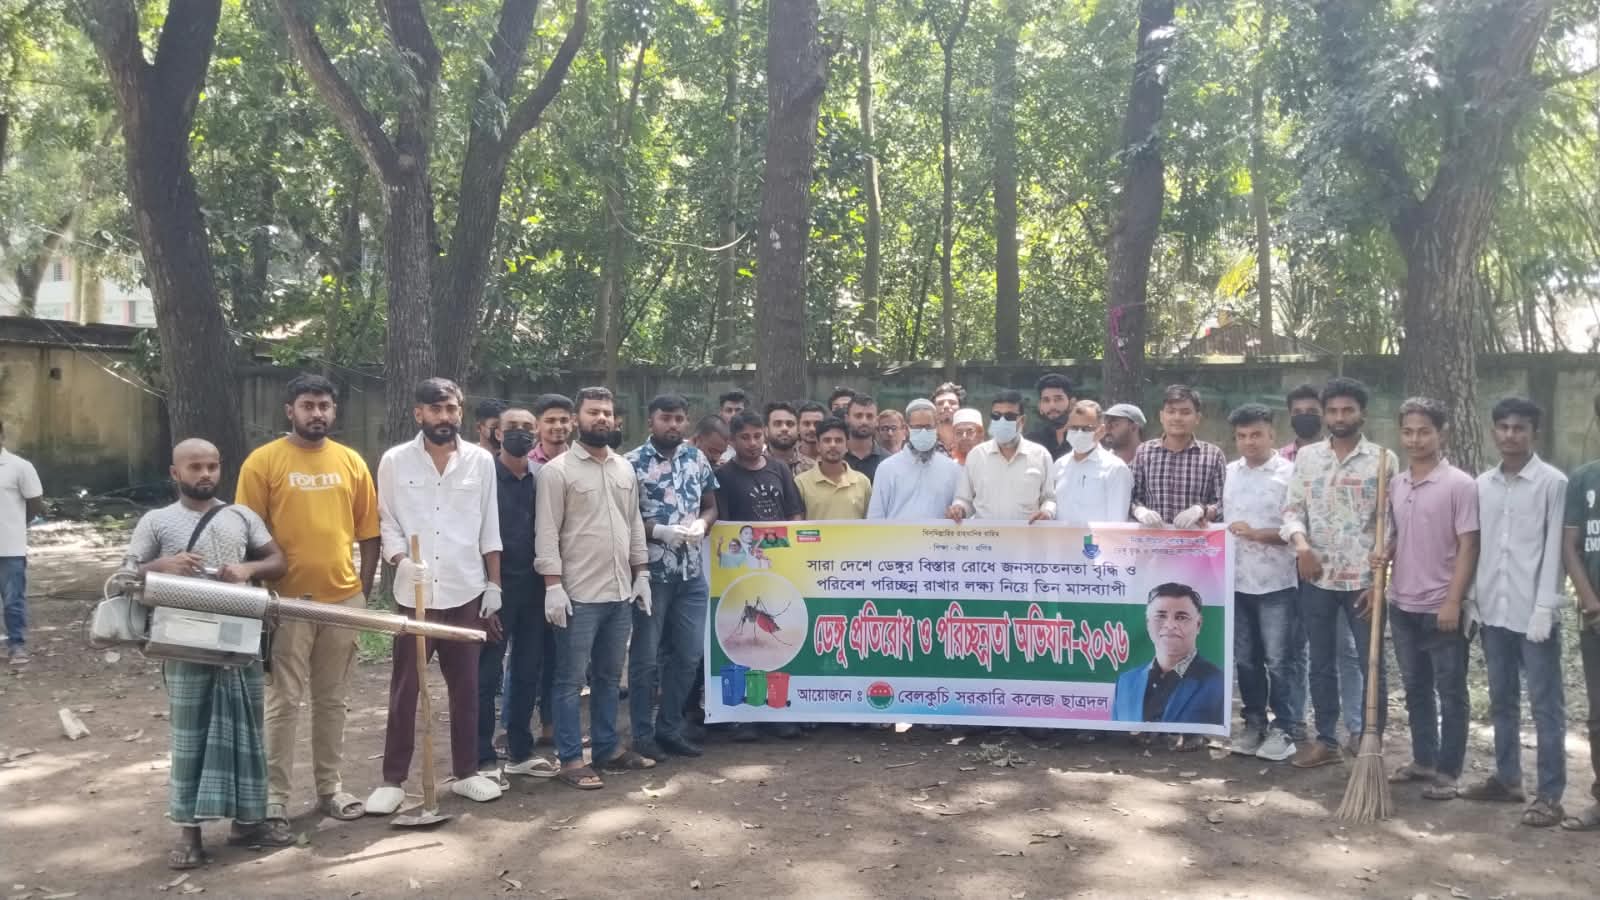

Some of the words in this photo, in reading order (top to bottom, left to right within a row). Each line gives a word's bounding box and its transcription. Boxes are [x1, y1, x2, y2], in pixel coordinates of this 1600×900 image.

[806, 559, 834, 572] সারা
[840, 559, 872, 572] দেশে
[878, 560, 913, 574] ডেঙ্গুর
[918, 557, 955, 573] বিস্তার
[962, 561, 996, 573] রোধে
[1000, 562, 1087, 577] জনসচেতনতা
[1093, 561, 1119, 580] বৃদ্ধি
[1125, 566, 1136, 576] ও
[816, 576, 865, 592] পরিবেশ
[871, 576, 918, 594] পরিচ্ছন্ন
[923, 579, 959, 593] রাখার
[965, 580, 994, 593] লক্ষ্য
[1000, 577, 1028, 593] নিয়ে
[1033, 578, 1061, 594] তিন
[1066, 580, 1128, 597] মাসব্যাপী
[814, 614, 848, 669] ডেঙ্গু
[849, 600, 915, 662] প্রতিরোধ
[918, 617, 932, 655] ও
[936, 601, 1012, 672] পরিচ্ছন্নতা
[898, 686, 950, 707] বেলকুচি
[954, 688, 1006, 706] সরকারি
[1011, 692, 1055, 707] কলেজ
[1061, 693, 1109, 710] ছাত্রদল
